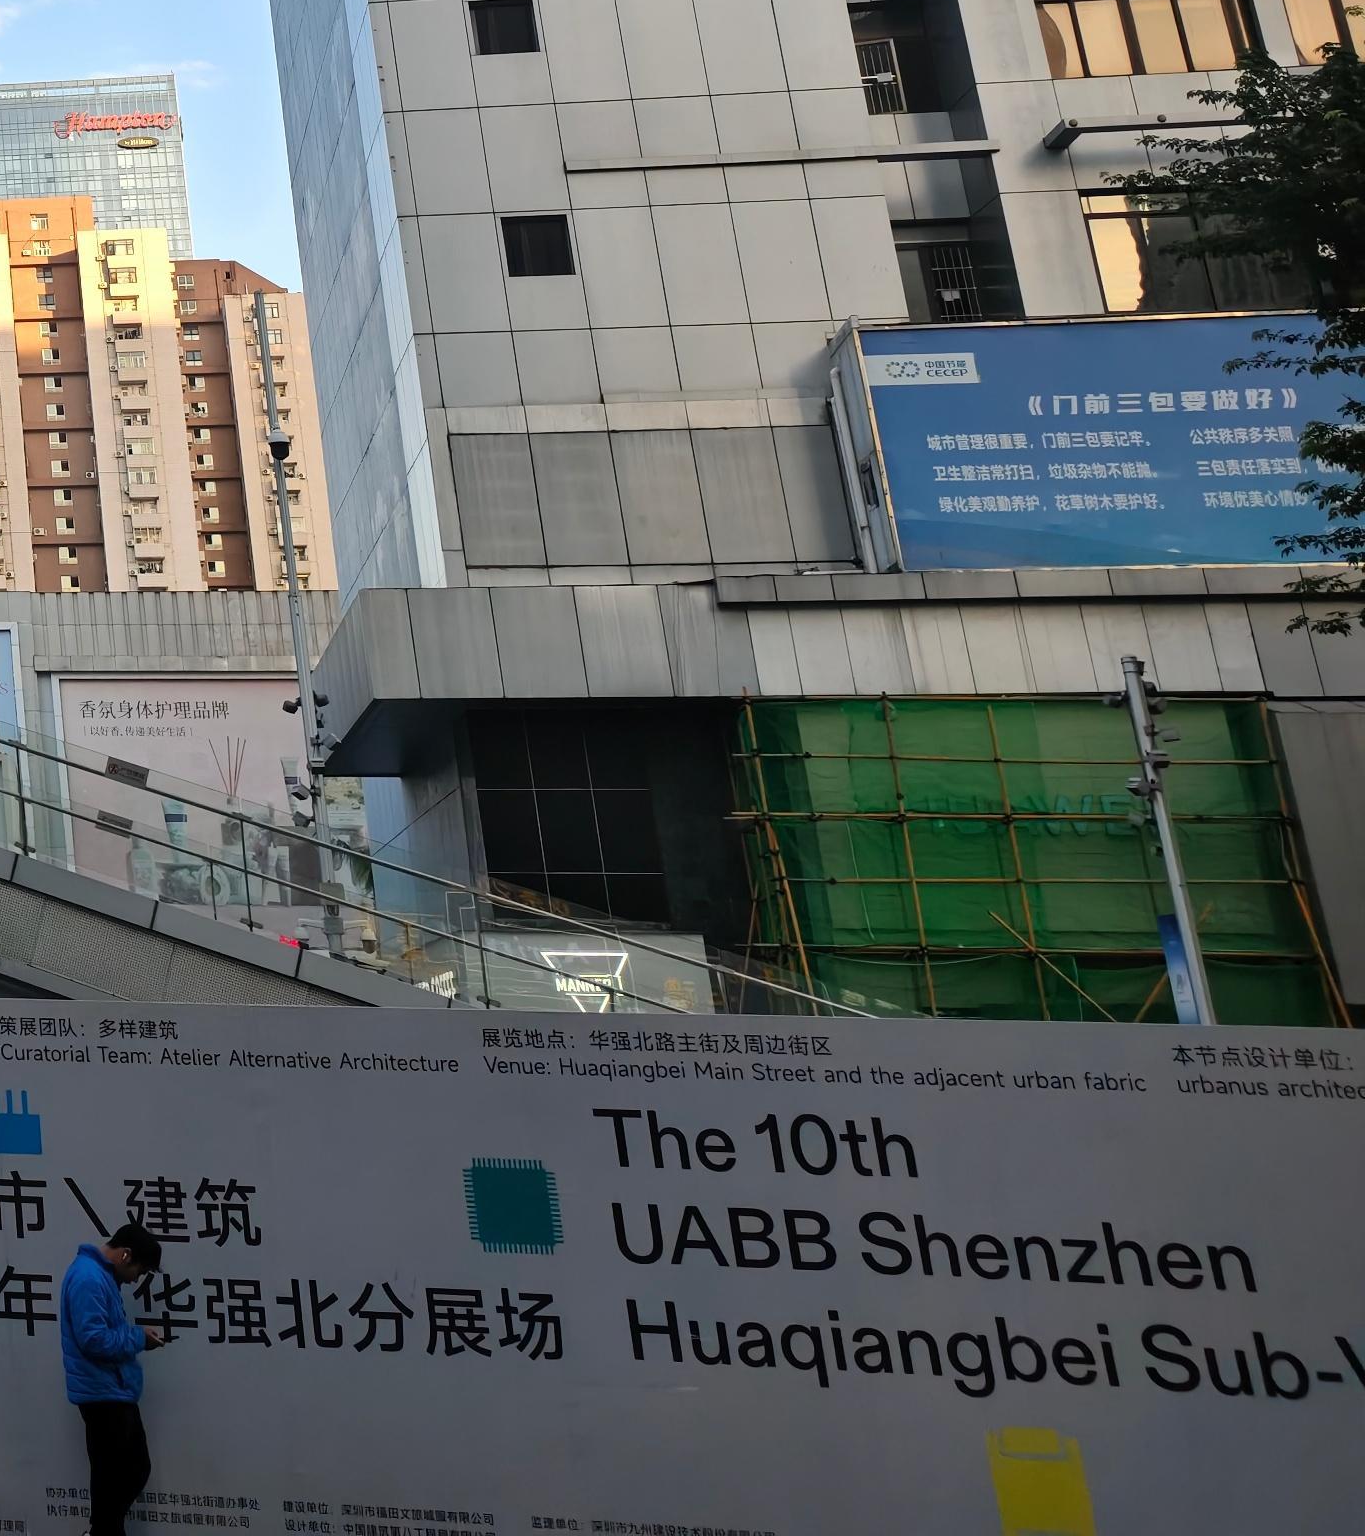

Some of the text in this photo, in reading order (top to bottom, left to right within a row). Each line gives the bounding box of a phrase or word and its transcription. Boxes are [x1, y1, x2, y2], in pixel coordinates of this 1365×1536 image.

[54, 110, 177, 139] Hampton
[924, 360, 966, 369] 中国节能
[926, 368, 968, 377] CECEP
[1028, 388, 1298, 417] 《门前三包要做好》
[79, 700, 230, 721] 香氛身体护理品牌
[0, 1016, 179, 1041] 策展团队：多样建筑
[481, 1027, 833, 1057] 展览地点：华强北路主街及周边街区
[0, 1043, 91, 1064] Curatorial
[97, 1046, 152, 1066] Team:
[160, 1047, 221, 1067] Atelier
[229, 1049, 331, 1070] Alternative
[339, 1052, 459, 1074] Architecture
[483, 1055, 1147, 1094] Venue: Huaqiangbei Main Street and the adjacent urban fabric
[1178, 1077, 1365, 1101] urbanus architec
[592, 1107, 920, 1178] The 10th
[610, 1202, 1258, 1293] UABB Shenzhen
[626, 1298, 1121, 1399] Huaqiangbei
